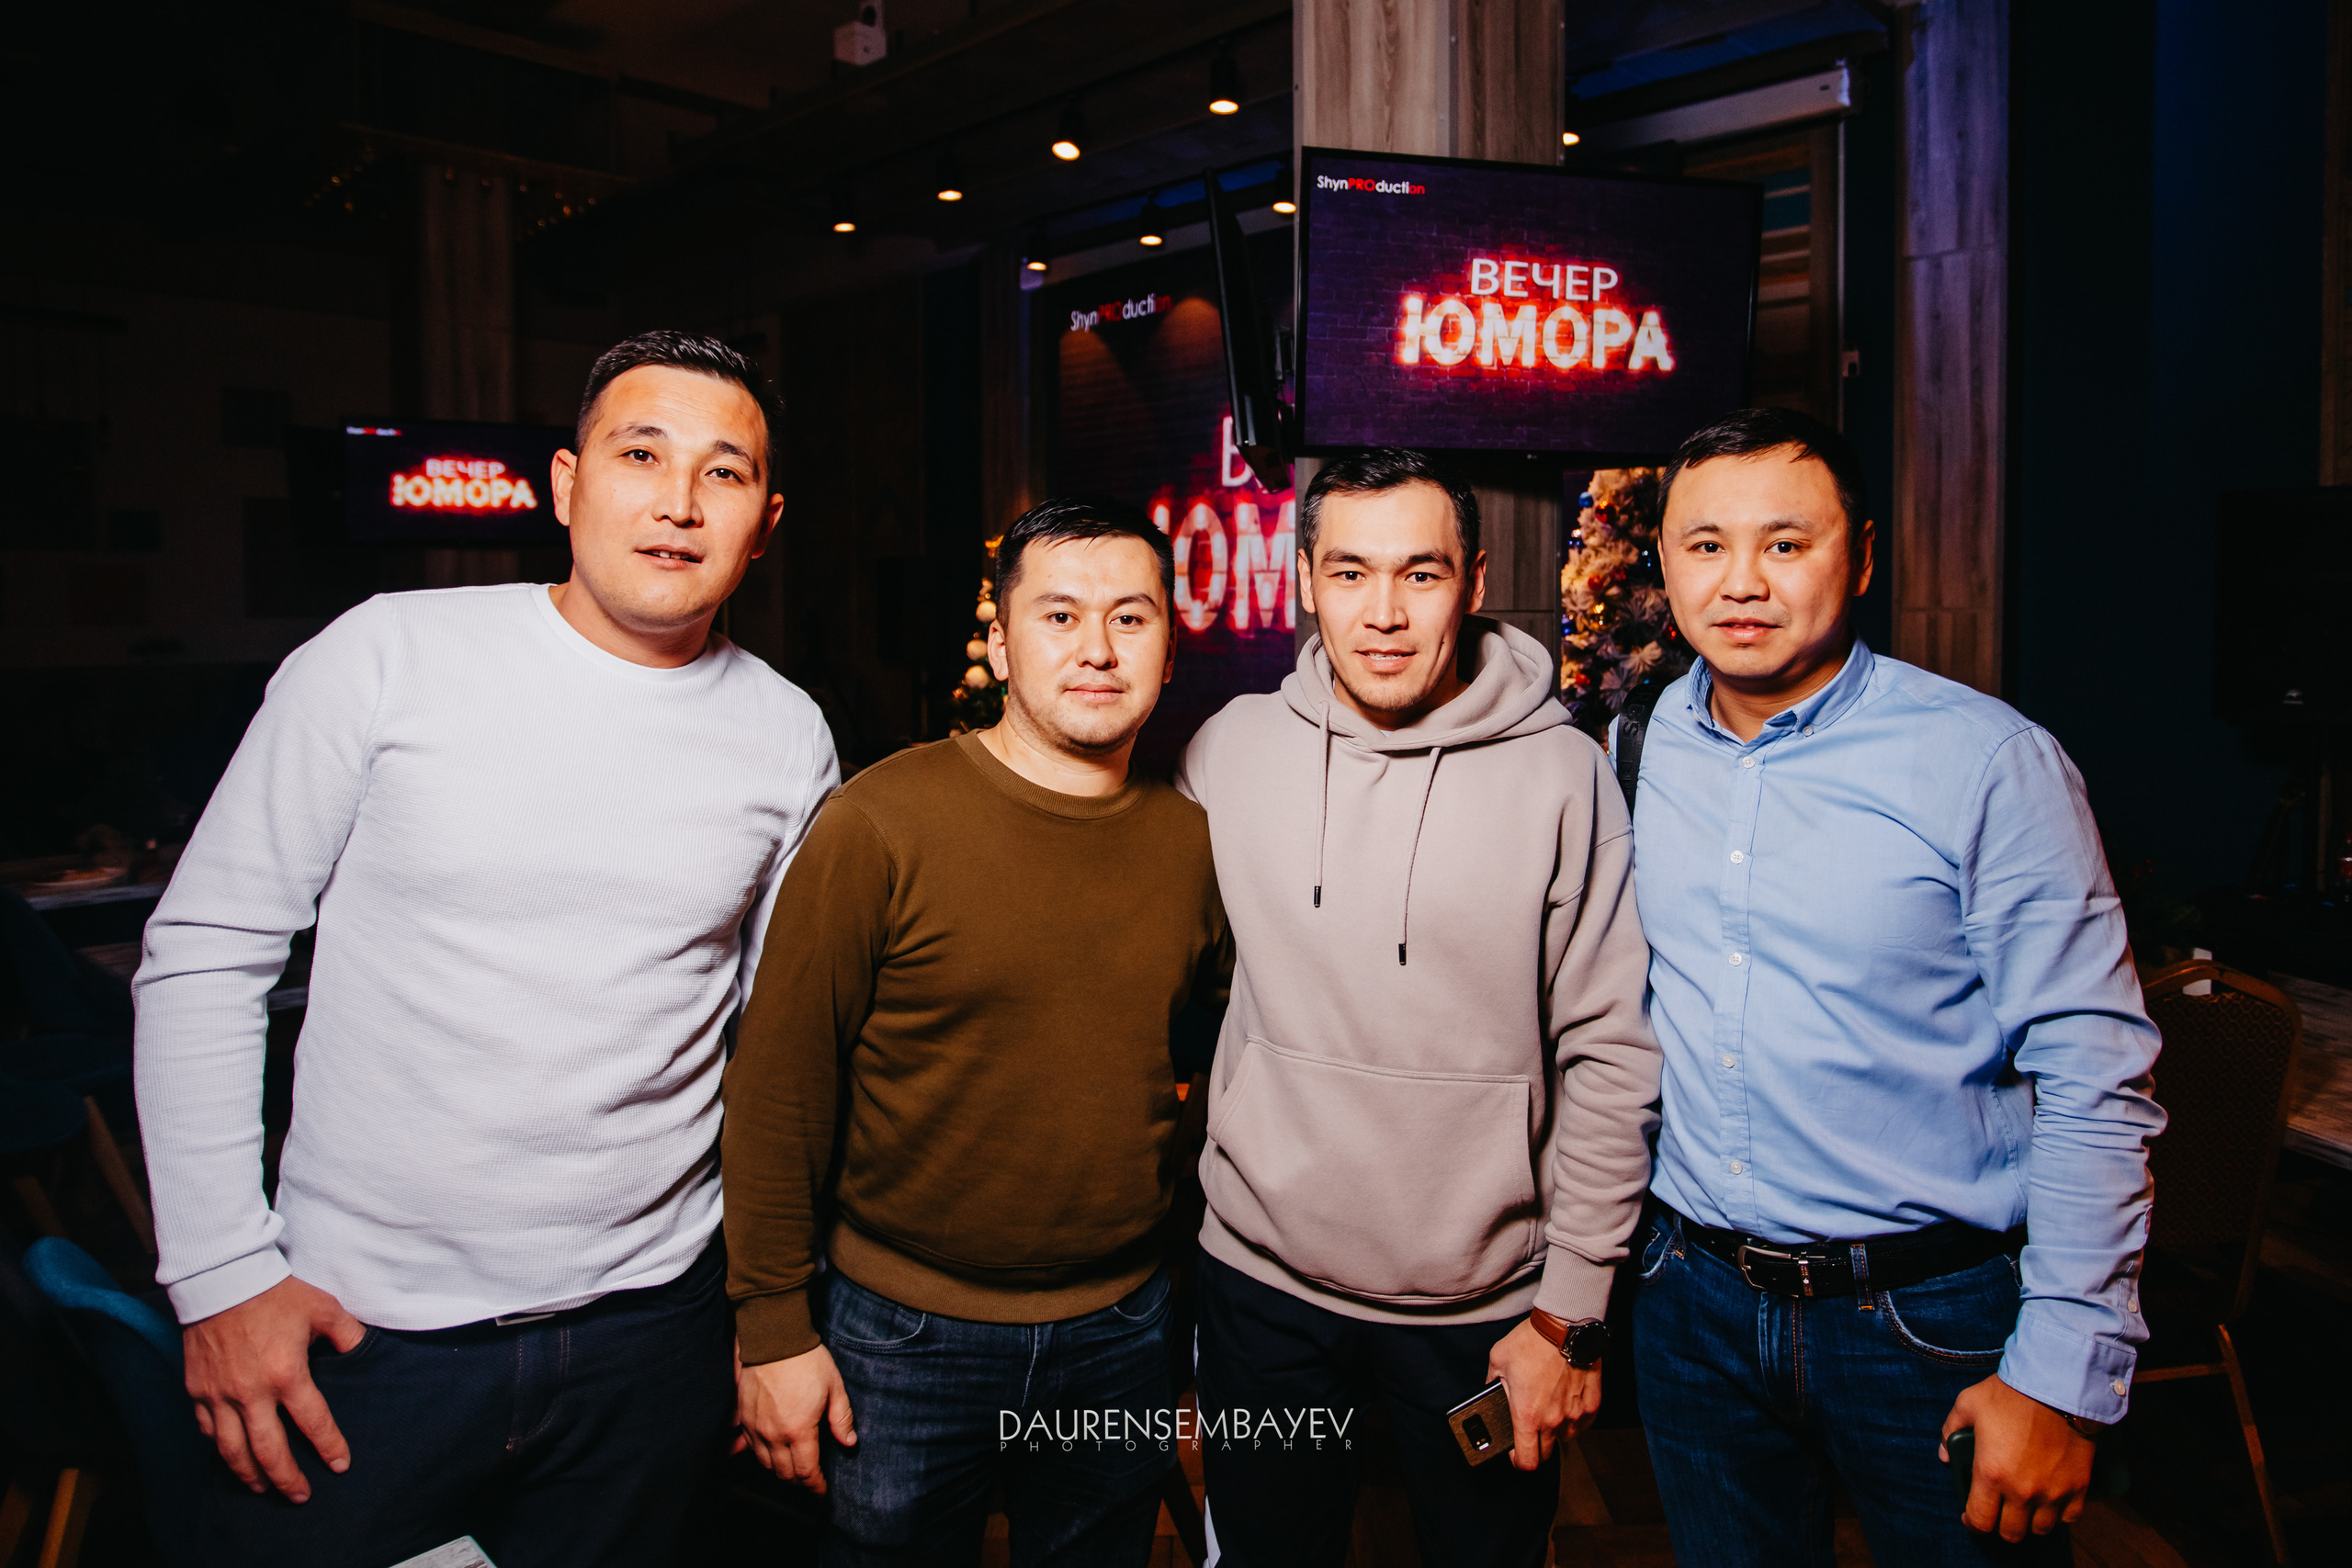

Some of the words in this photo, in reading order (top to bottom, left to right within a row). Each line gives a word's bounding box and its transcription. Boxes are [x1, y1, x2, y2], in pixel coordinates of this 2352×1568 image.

[1317, 175, 1426, 195] ShynPROduction
[1470, 257, 1619, 302] ВЕЧЕР
[1397, 293, 1676, 374] ЮМОРА
[424, 457, 506, 479] ВЕЧЕР
[391, 473, 538, 509] ЮМОРА
